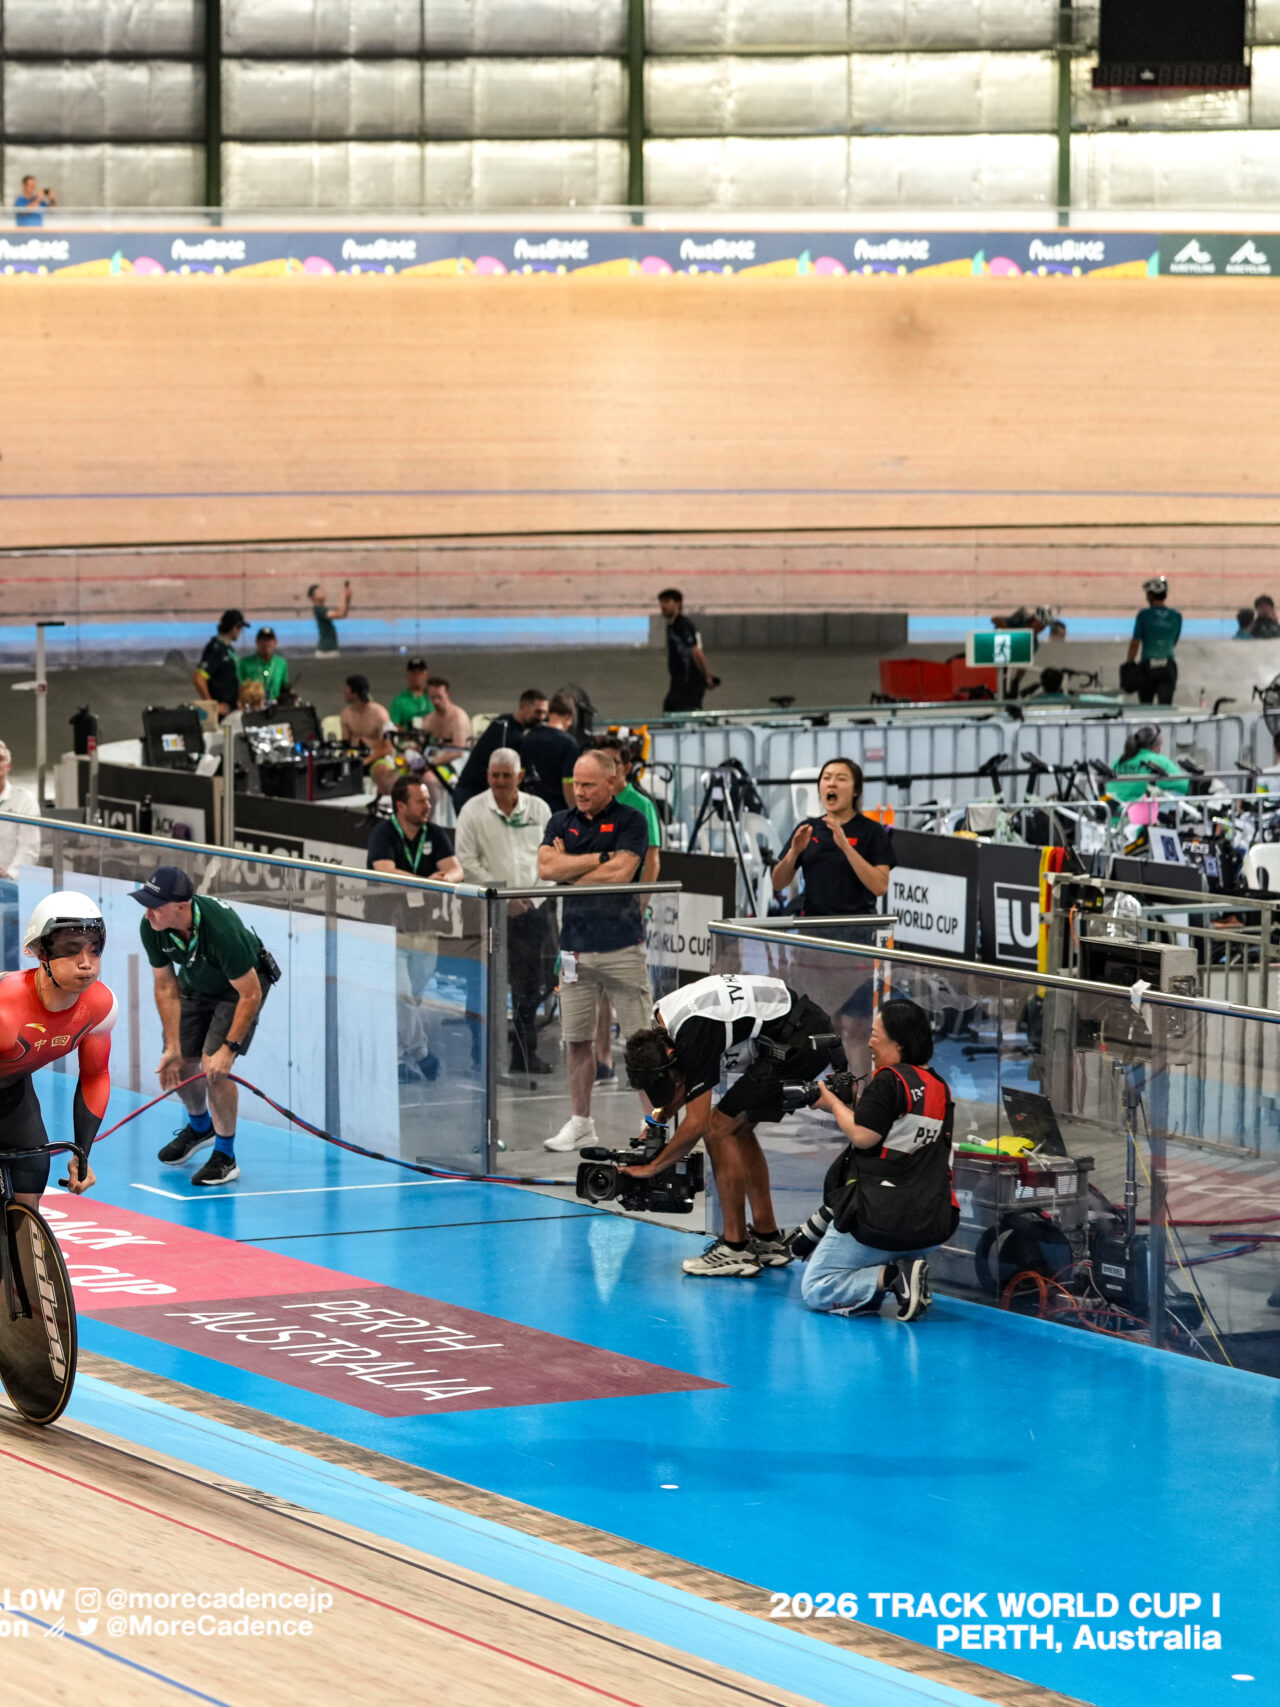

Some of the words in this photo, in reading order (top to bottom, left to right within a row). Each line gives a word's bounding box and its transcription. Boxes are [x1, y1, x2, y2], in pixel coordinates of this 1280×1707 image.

[893, 882, 928, 904] TRACK
[893, 908, 933, 931] WORLD
[936, 915, 958, 936] CUP
[726, 984, 744, 1004] TV
[65, 1264, 177, 1295] CUP
[282, 1300, 504, 1353] PERTH
[164, 1312, 494, 1401] AUSTRALIA
